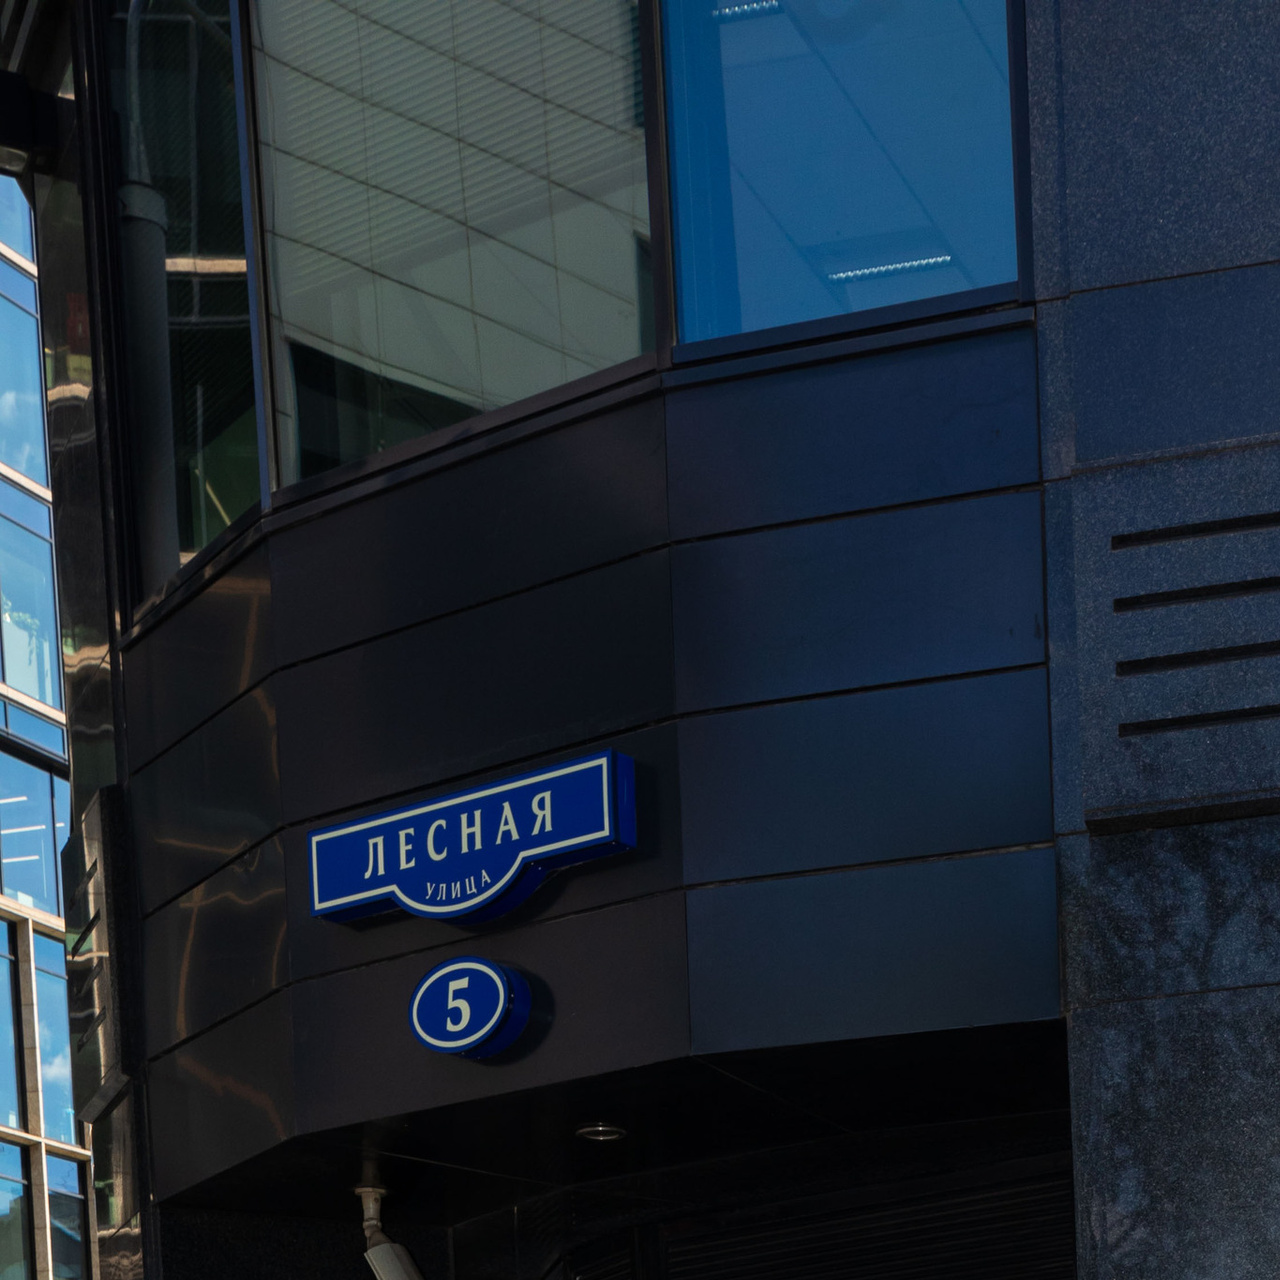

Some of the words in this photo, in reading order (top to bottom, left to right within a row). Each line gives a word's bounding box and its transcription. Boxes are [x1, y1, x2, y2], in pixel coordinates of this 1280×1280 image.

[364, 790, 553, 880] ЛЕСНАЯ
[425, 869, 491, 901] УЛИЦА
[446, 976, 471, 1032] 5
